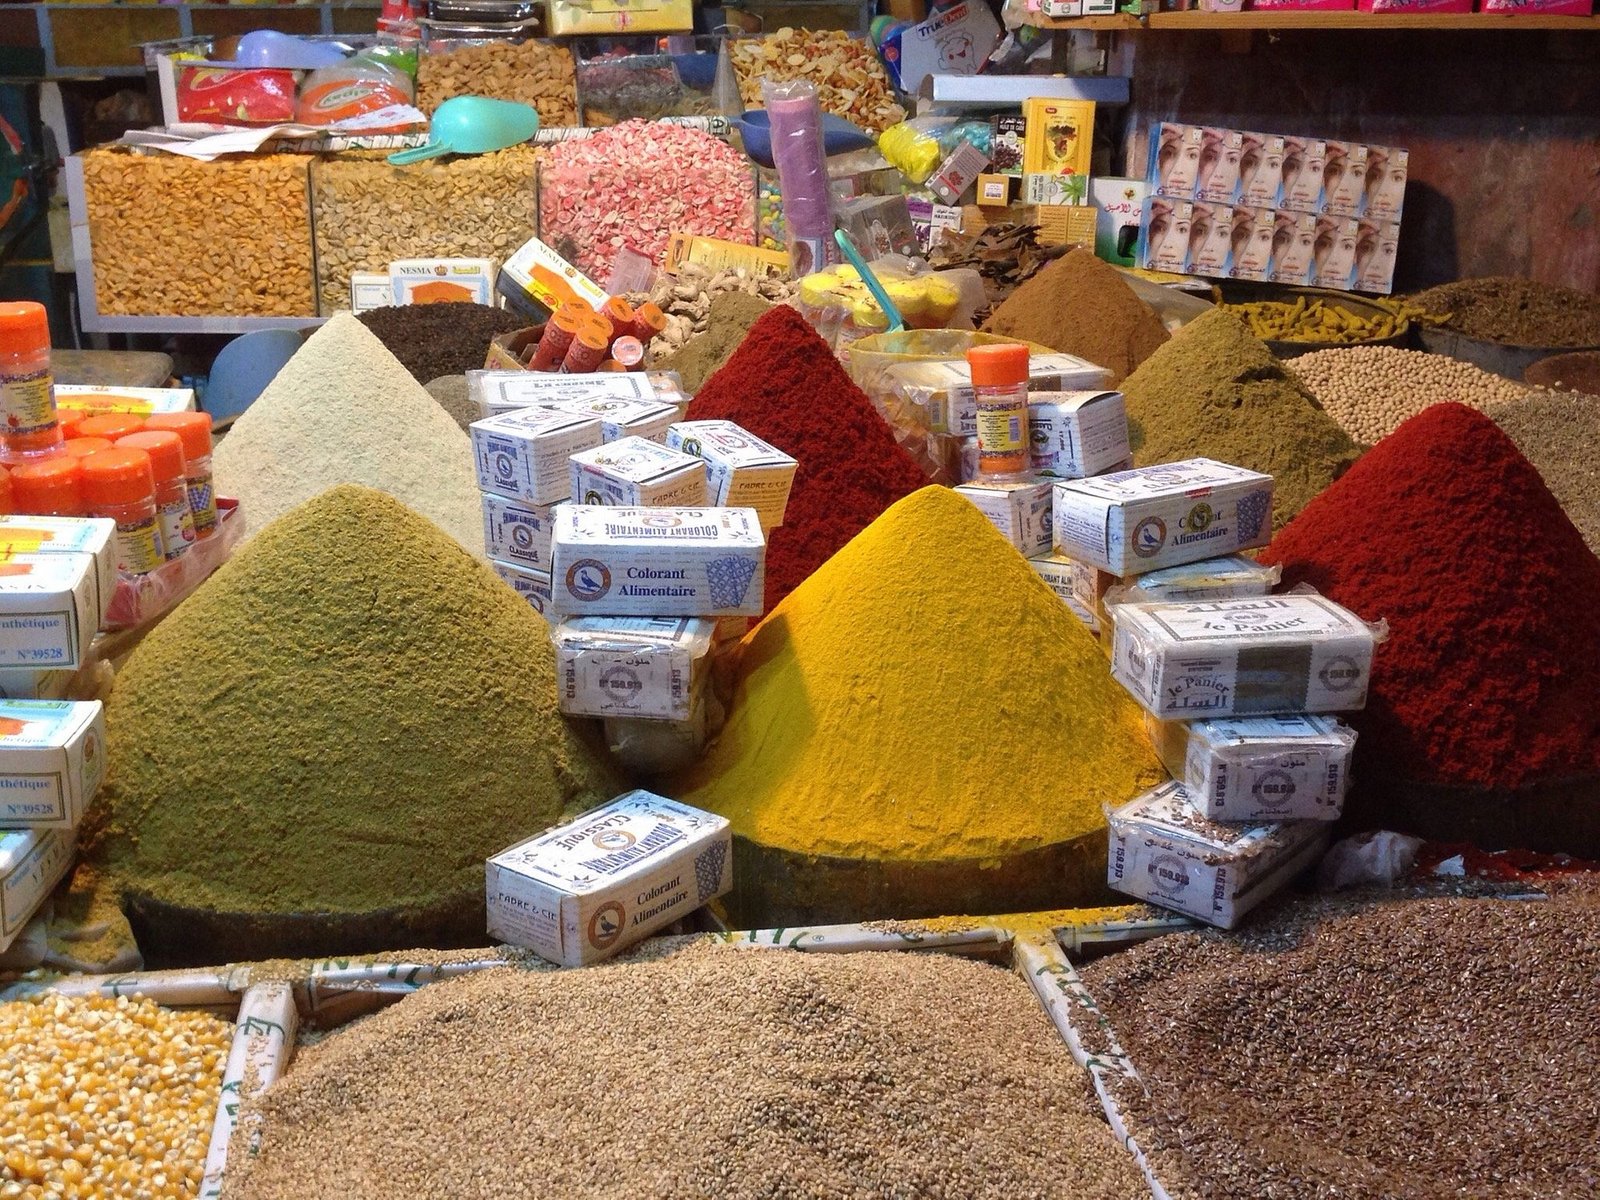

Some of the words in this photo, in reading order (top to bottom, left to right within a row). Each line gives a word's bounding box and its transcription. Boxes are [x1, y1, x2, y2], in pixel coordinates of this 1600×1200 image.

[400, 266, 431, 275] NESMA
[605, 523, 668, 536] ALIMENTAIRE
[670, 524, 718, 537] COLORANT
[1170, 526, 1228, 548] Alimentaire
[626, 566, 685, 579] Colorant
[618, 585, 697, 597] Alimentaire
[1203, 621, 1226, 632] le
[1234, 616, 1308, 632] Panier
[17, 648, 63, 661] N°39528
[1168, 685, 1183, 697] le
[1186, 677, 1230, 693] Panier
[1327, 763, 1339, 795] 159.913
[1215, 774, 1227, 807] 159.913
[7, 803, 55, 815] N°39528
[557, 814, 630, 852] CLASSIQUE
[1114, 846, 1126, 879] 159.913
[636, 874, 682, 906] Colorant
[1213, 867, 1226, 900] 159.913
[630, 889, 689, 928] Alimentaire
